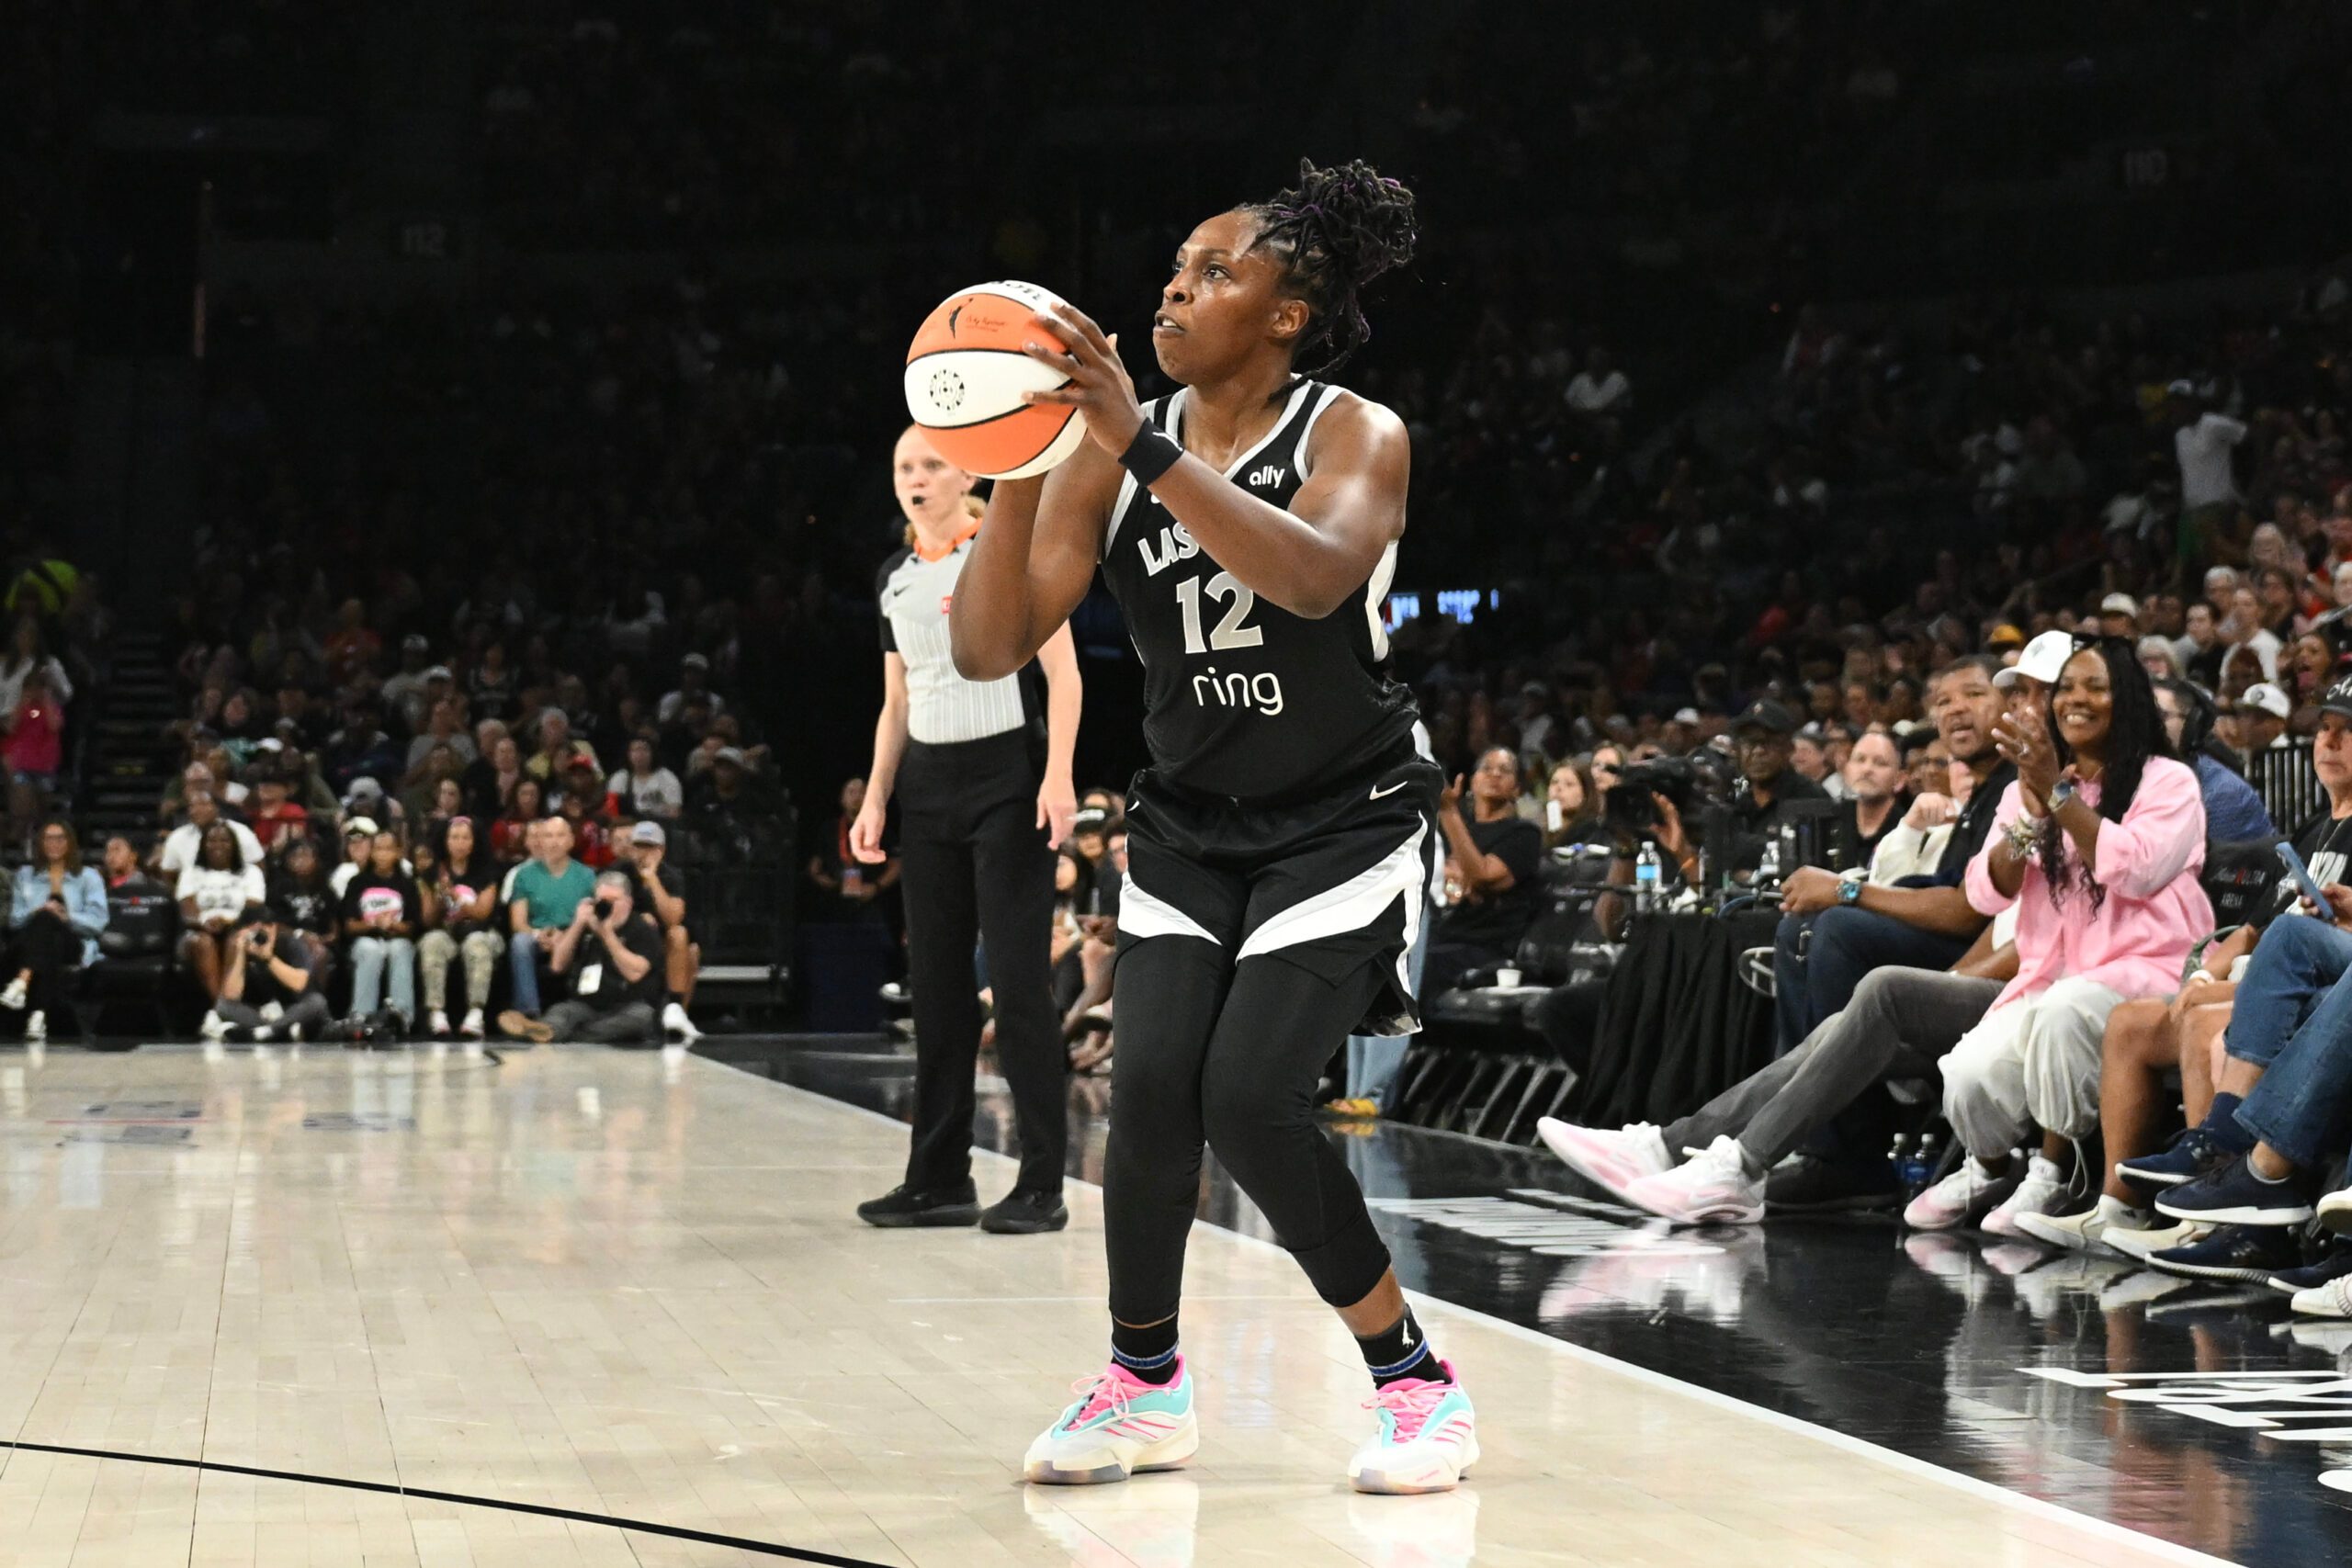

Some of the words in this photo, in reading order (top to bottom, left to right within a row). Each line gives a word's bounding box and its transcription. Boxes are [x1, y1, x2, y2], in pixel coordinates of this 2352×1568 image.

[1249, 465, 1285, 489] ally
[1136, 521, 1200, 577] LAS
[1176, 570, 1264, 654] 12
[1193, 666, 1283, 716] ring
